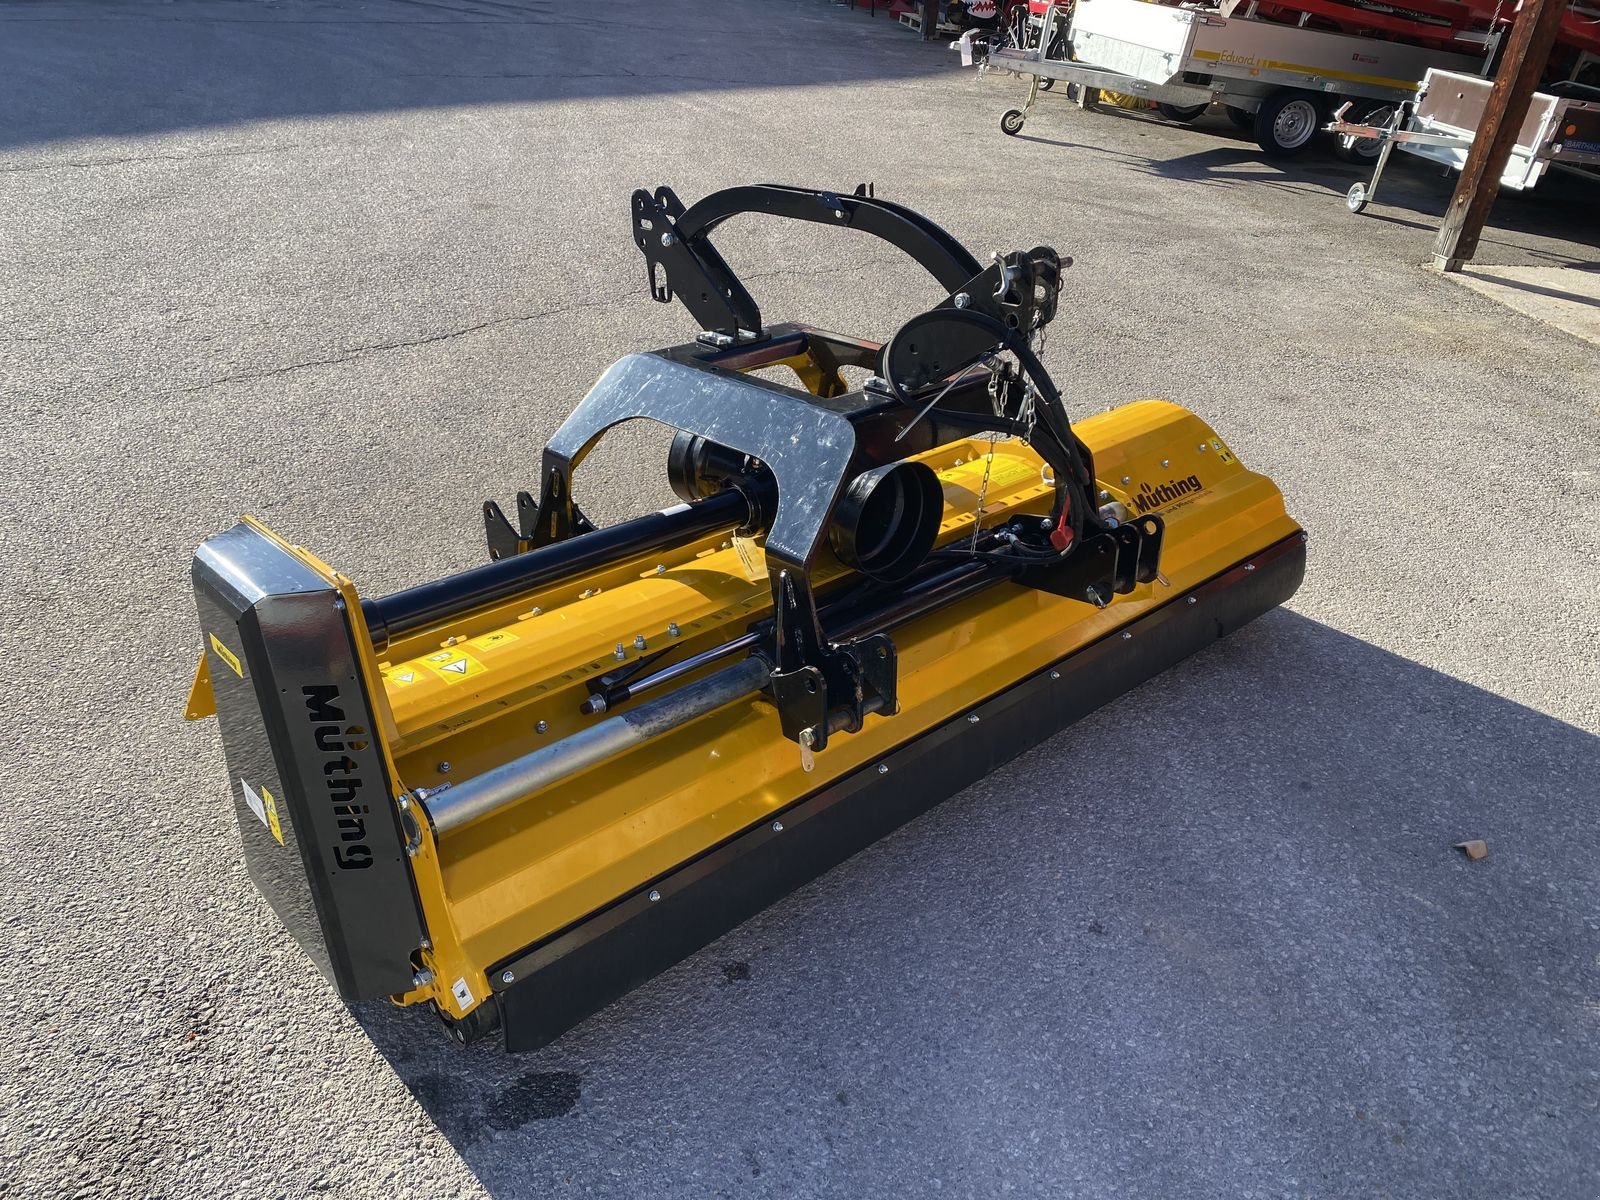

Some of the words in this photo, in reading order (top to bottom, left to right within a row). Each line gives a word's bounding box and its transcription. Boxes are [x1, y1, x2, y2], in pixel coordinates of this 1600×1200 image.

[1220, 49, 1256, 66] Eduard
[1132, 474, 1203, 515] Müthing
[301, 684, 374, 870] Müthing
